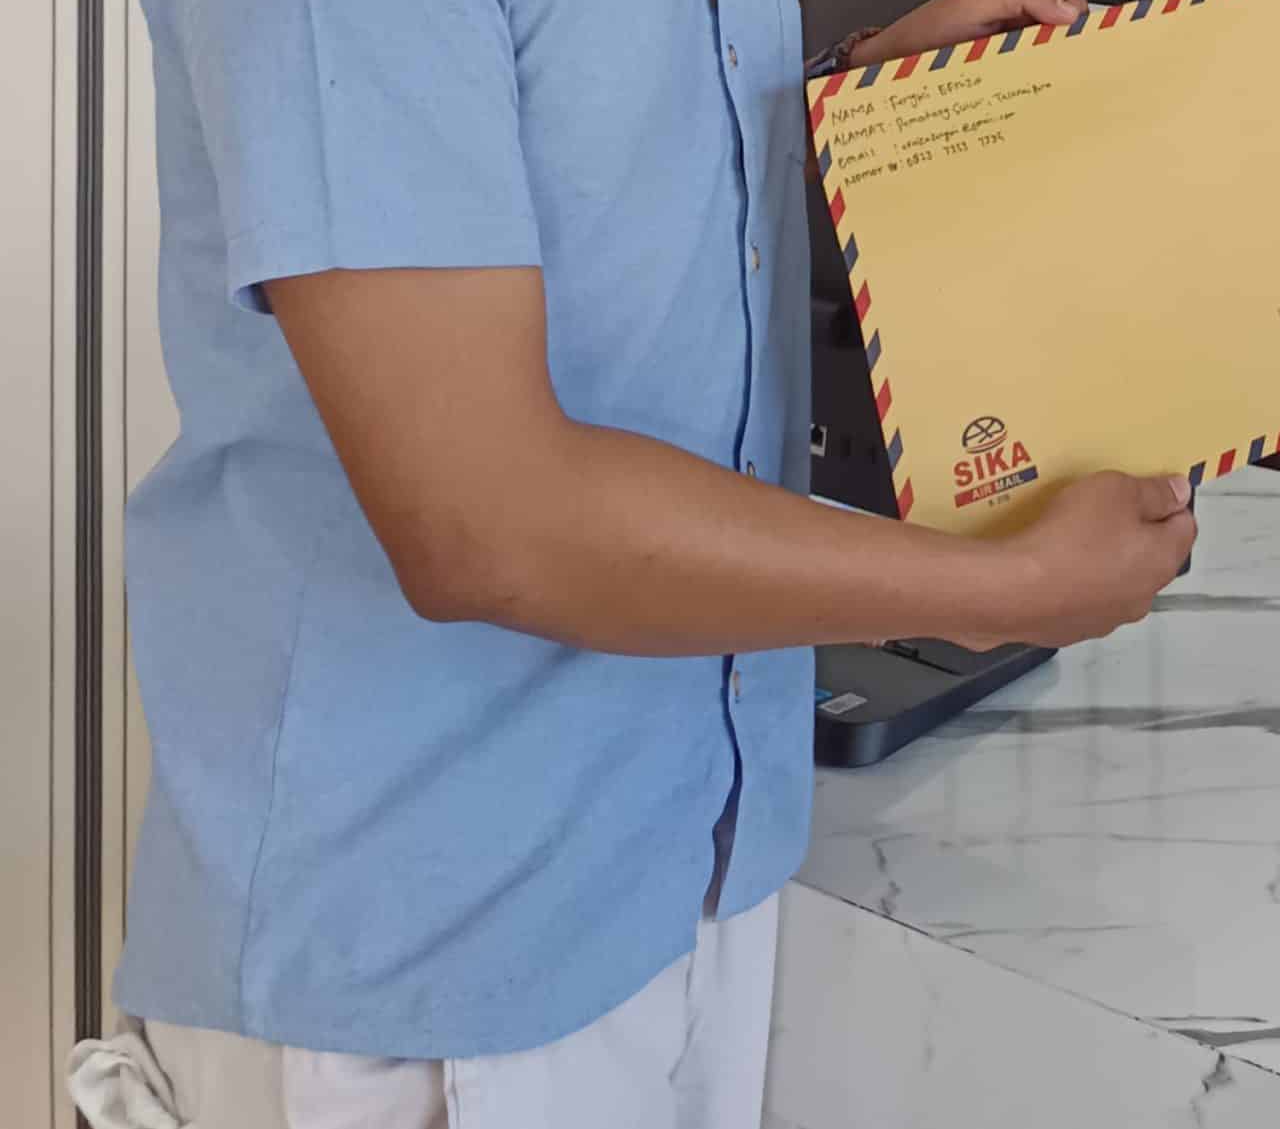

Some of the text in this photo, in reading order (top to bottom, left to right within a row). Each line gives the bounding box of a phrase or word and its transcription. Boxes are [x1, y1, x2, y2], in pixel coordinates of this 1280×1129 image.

[954, 440, 1032, 488] SIKA
[972, 483, 993, 501] AIR
[994, 473, 1024, 492] MAIL
